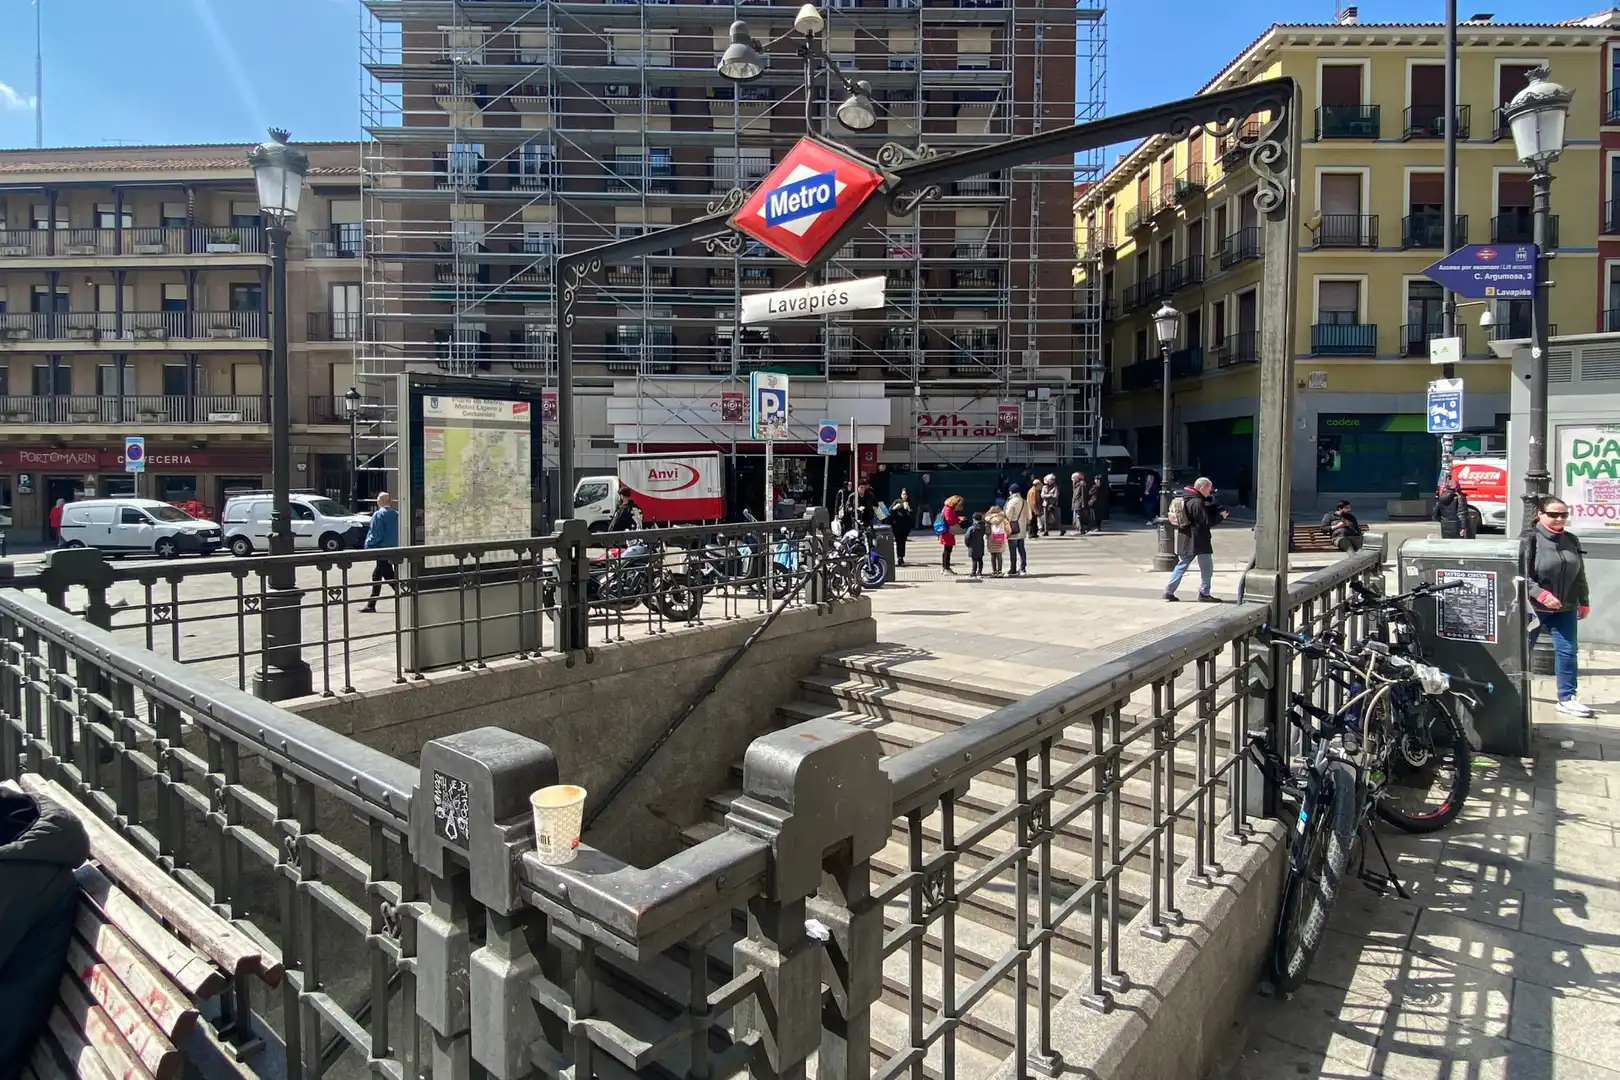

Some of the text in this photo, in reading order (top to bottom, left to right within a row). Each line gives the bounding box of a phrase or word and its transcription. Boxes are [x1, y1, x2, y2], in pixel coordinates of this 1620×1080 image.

[769, 183, 830, 218] Metro
[1484, 273, 1525, 281] Argumosa,
[1496, 288, 1532, 297] Lavapiés
[768, 288, 849, 314] Lavapiés
[761, 392, 780, 422] P
[972, 420, 998, 436] ab
[1326, 418, 1361, 426] codere
[1572, 437, 1620, 460] DÍA
[117, 455, 192, 464] CECERIA
[648, 468, 679, 479] Anvi
